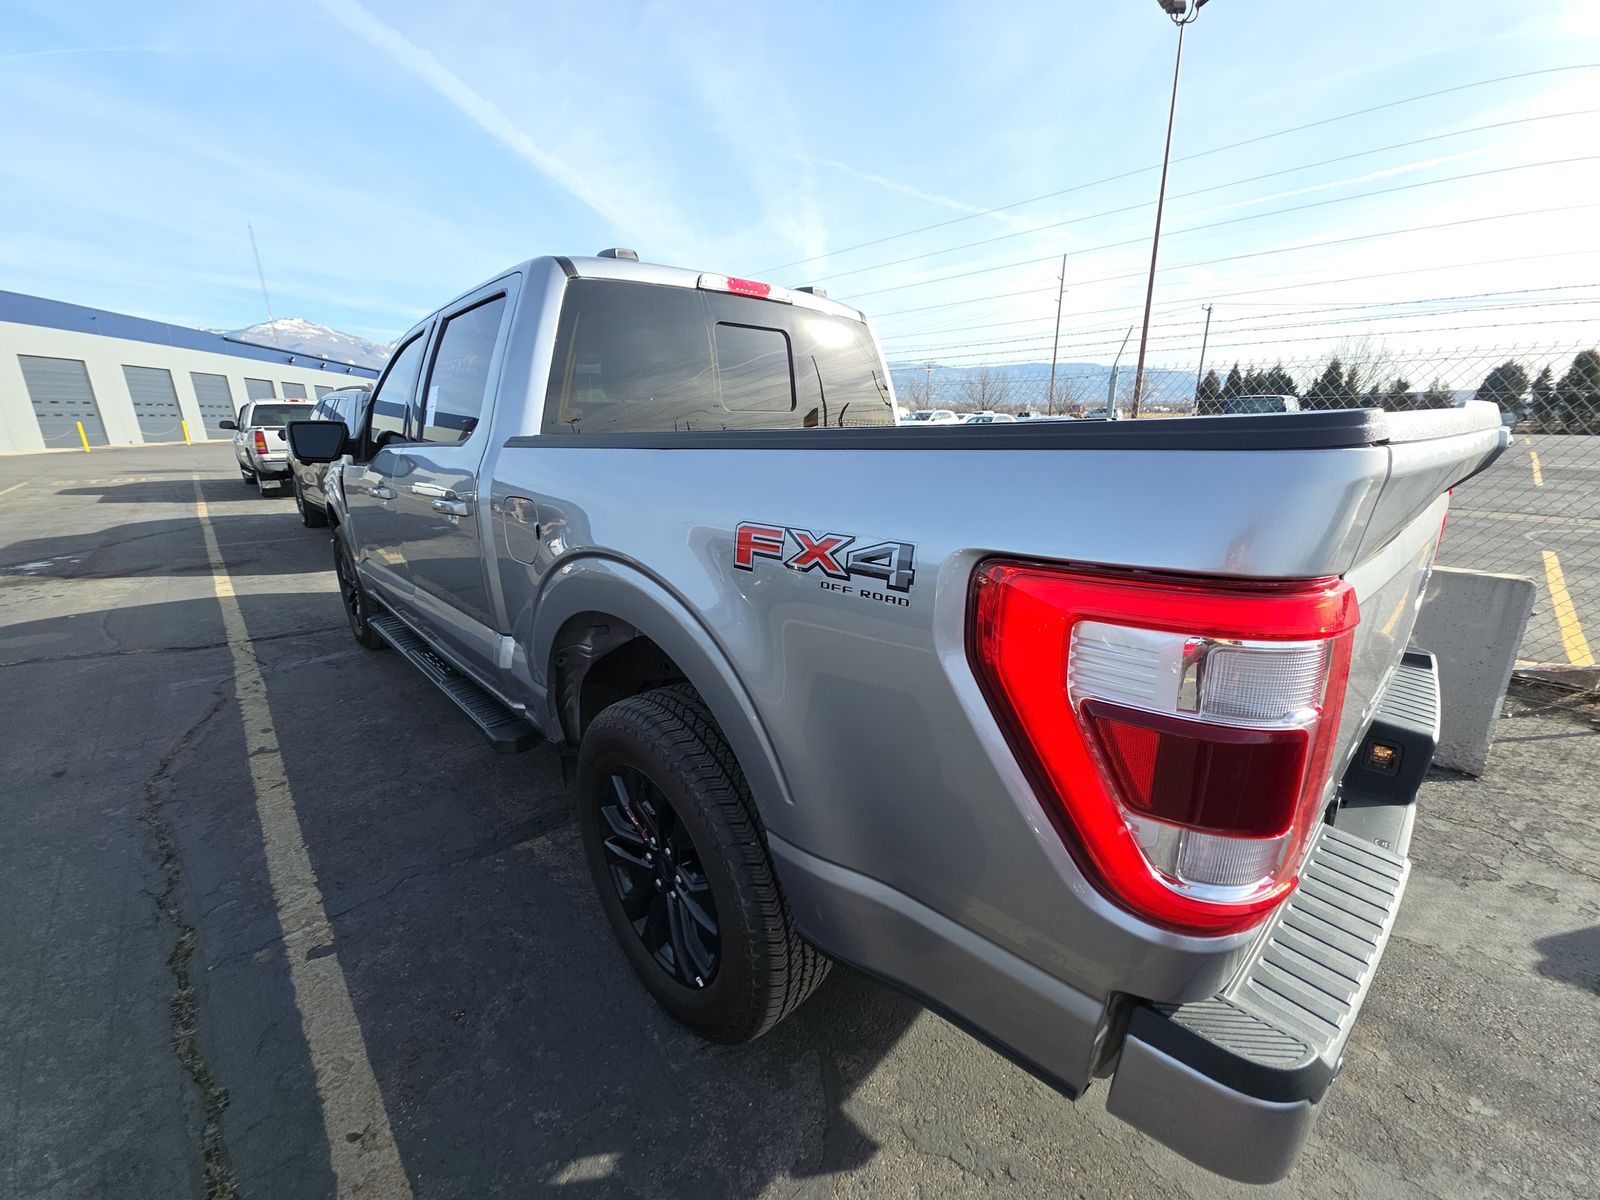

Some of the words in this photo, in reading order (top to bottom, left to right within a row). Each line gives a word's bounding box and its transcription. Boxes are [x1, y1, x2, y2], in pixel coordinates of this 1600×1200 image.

[734, 520, 915, 593] FX4
[820, 581, 853, 594] OFF
[860, 589, 910, 607] ROAD
